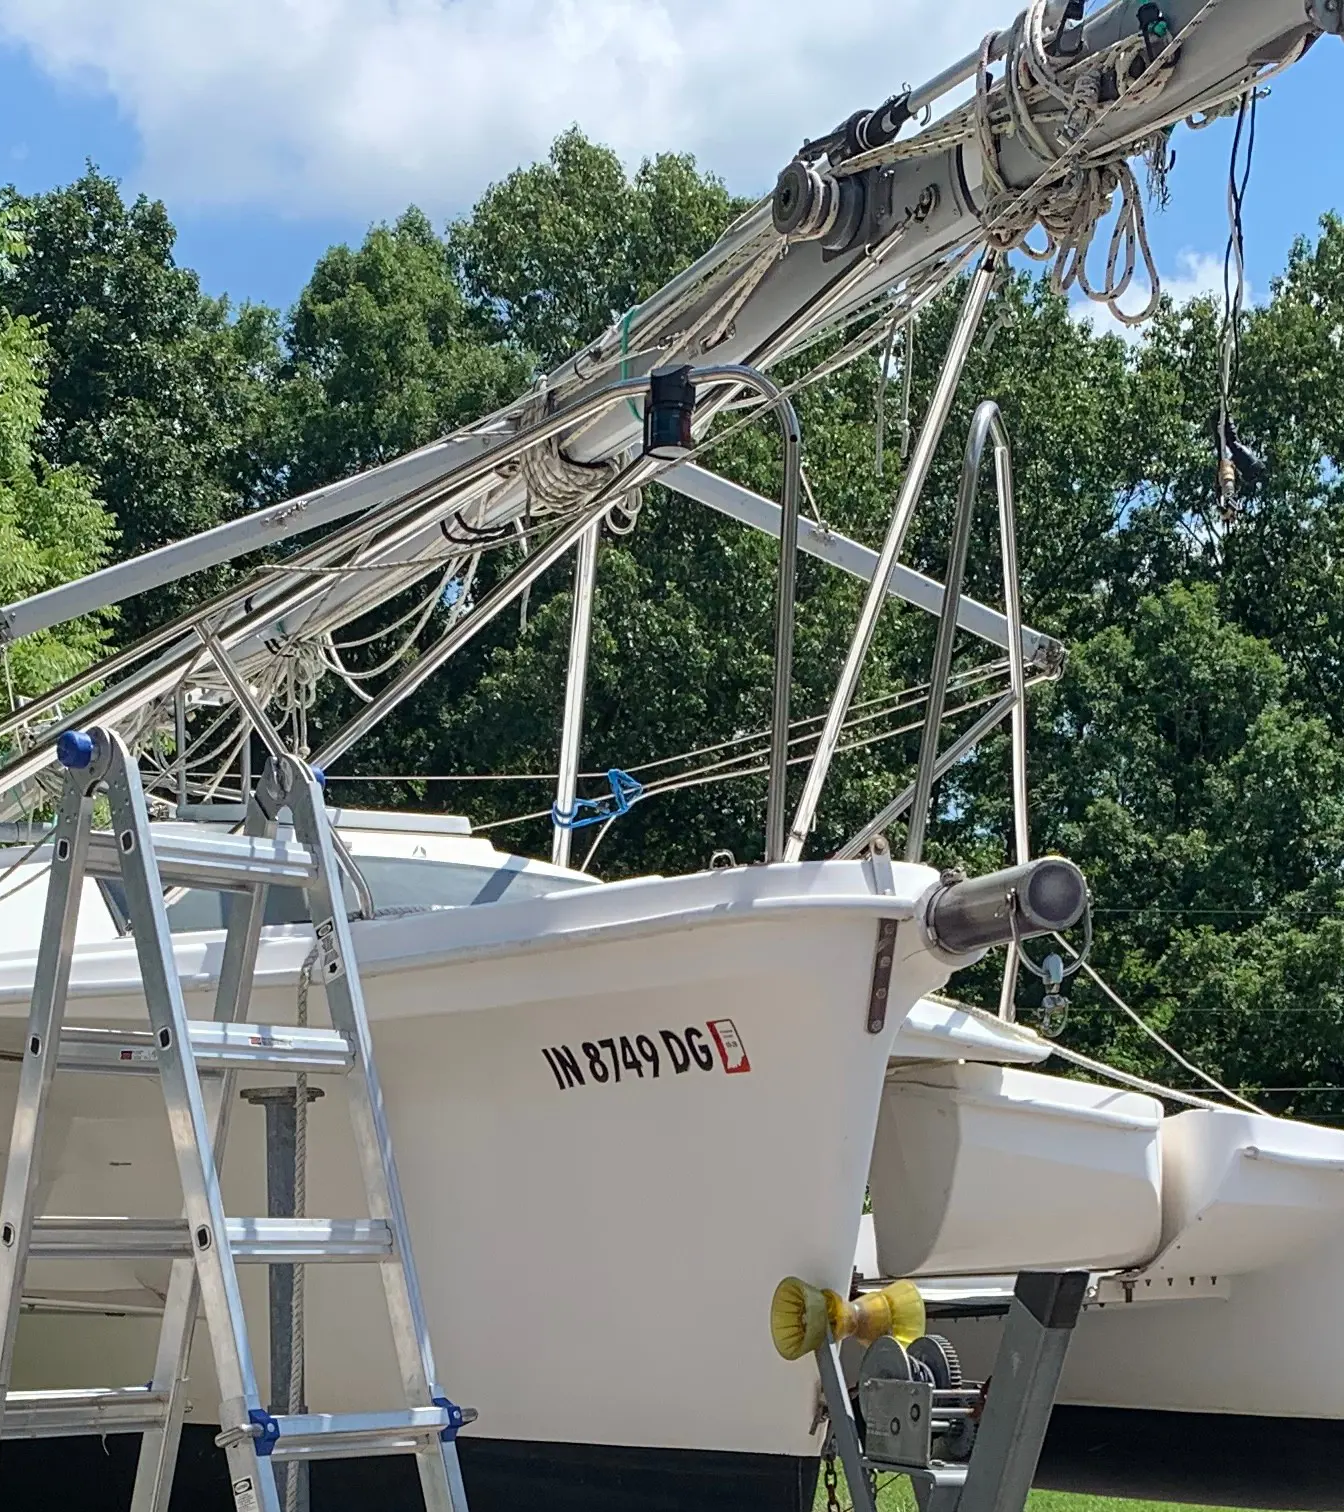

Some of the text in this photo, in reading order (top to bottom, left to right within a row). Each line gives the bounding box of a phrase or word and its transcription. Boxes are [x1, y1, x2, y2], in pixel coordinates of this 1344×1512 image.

[542, 1027, 713, 1090] IN 8749 DG
